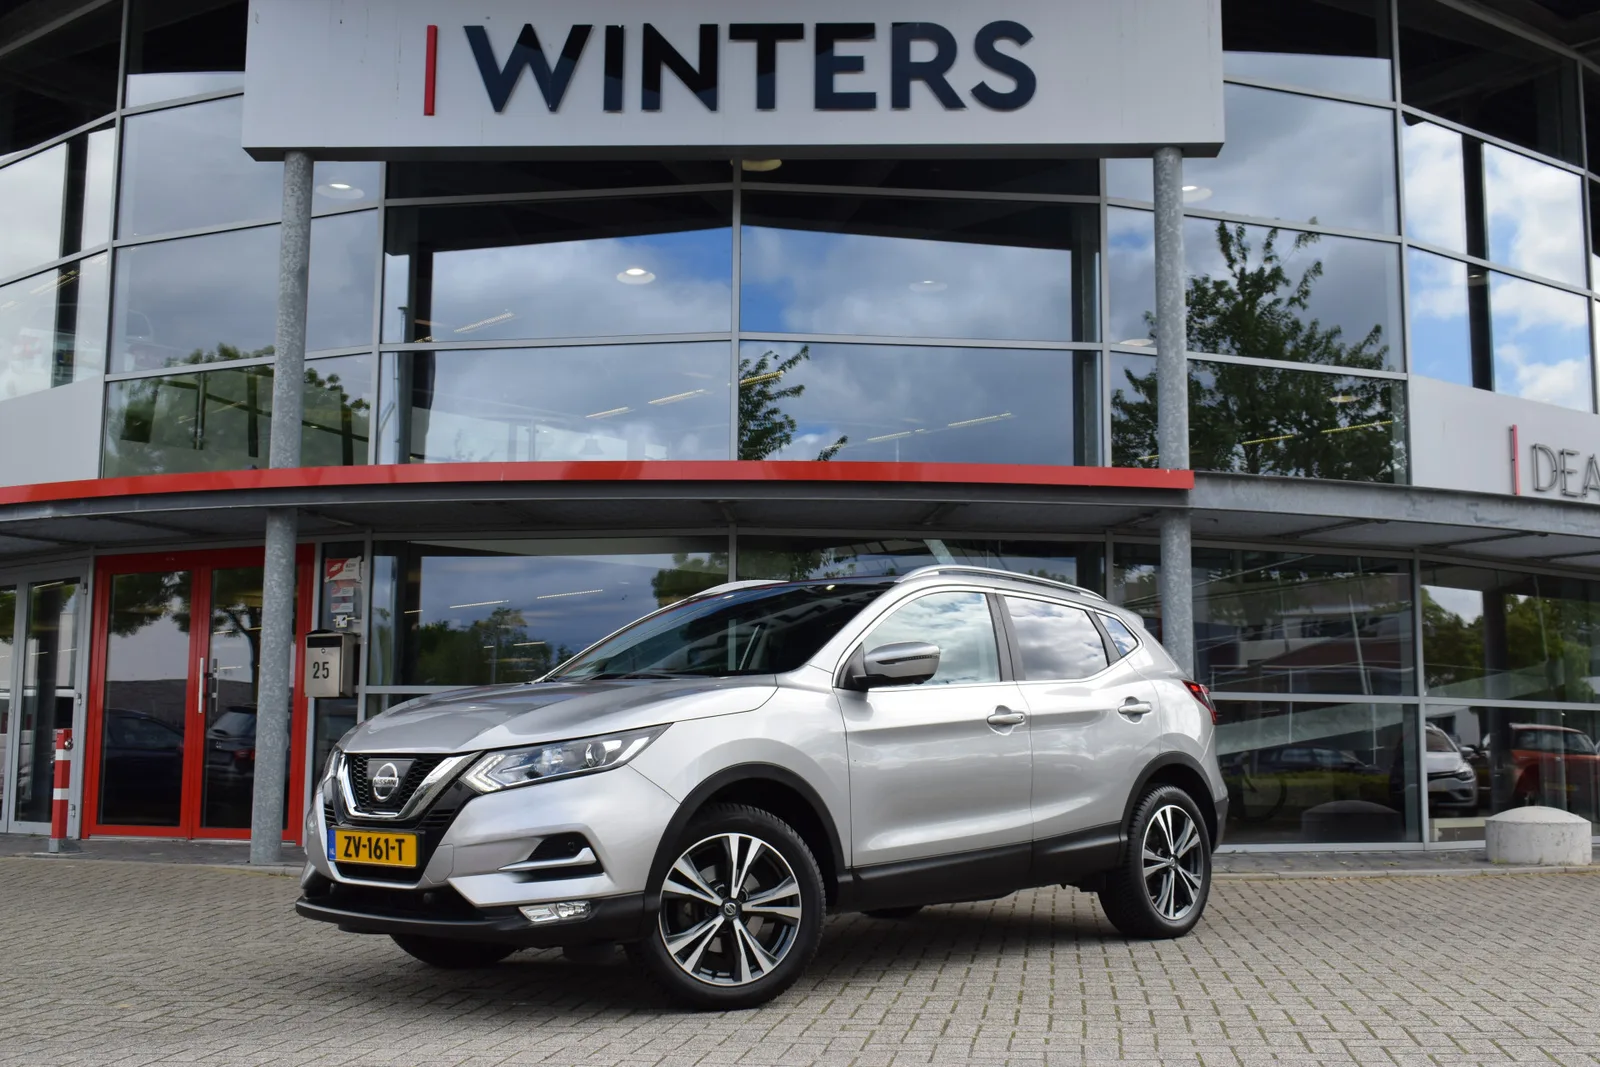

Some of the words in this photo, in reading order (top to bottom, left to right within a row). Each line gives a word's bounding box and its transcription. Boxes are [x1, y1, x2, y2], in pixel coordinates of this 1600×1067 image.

[464, 20, 1037, 113] WINTERS
[1530, 443, 1600, 498] DEA
[312, 661, 330, 679] 25
[373, 778, 397, 787] NISSAN
[343, 835, 405, 861] ZV-161-T
